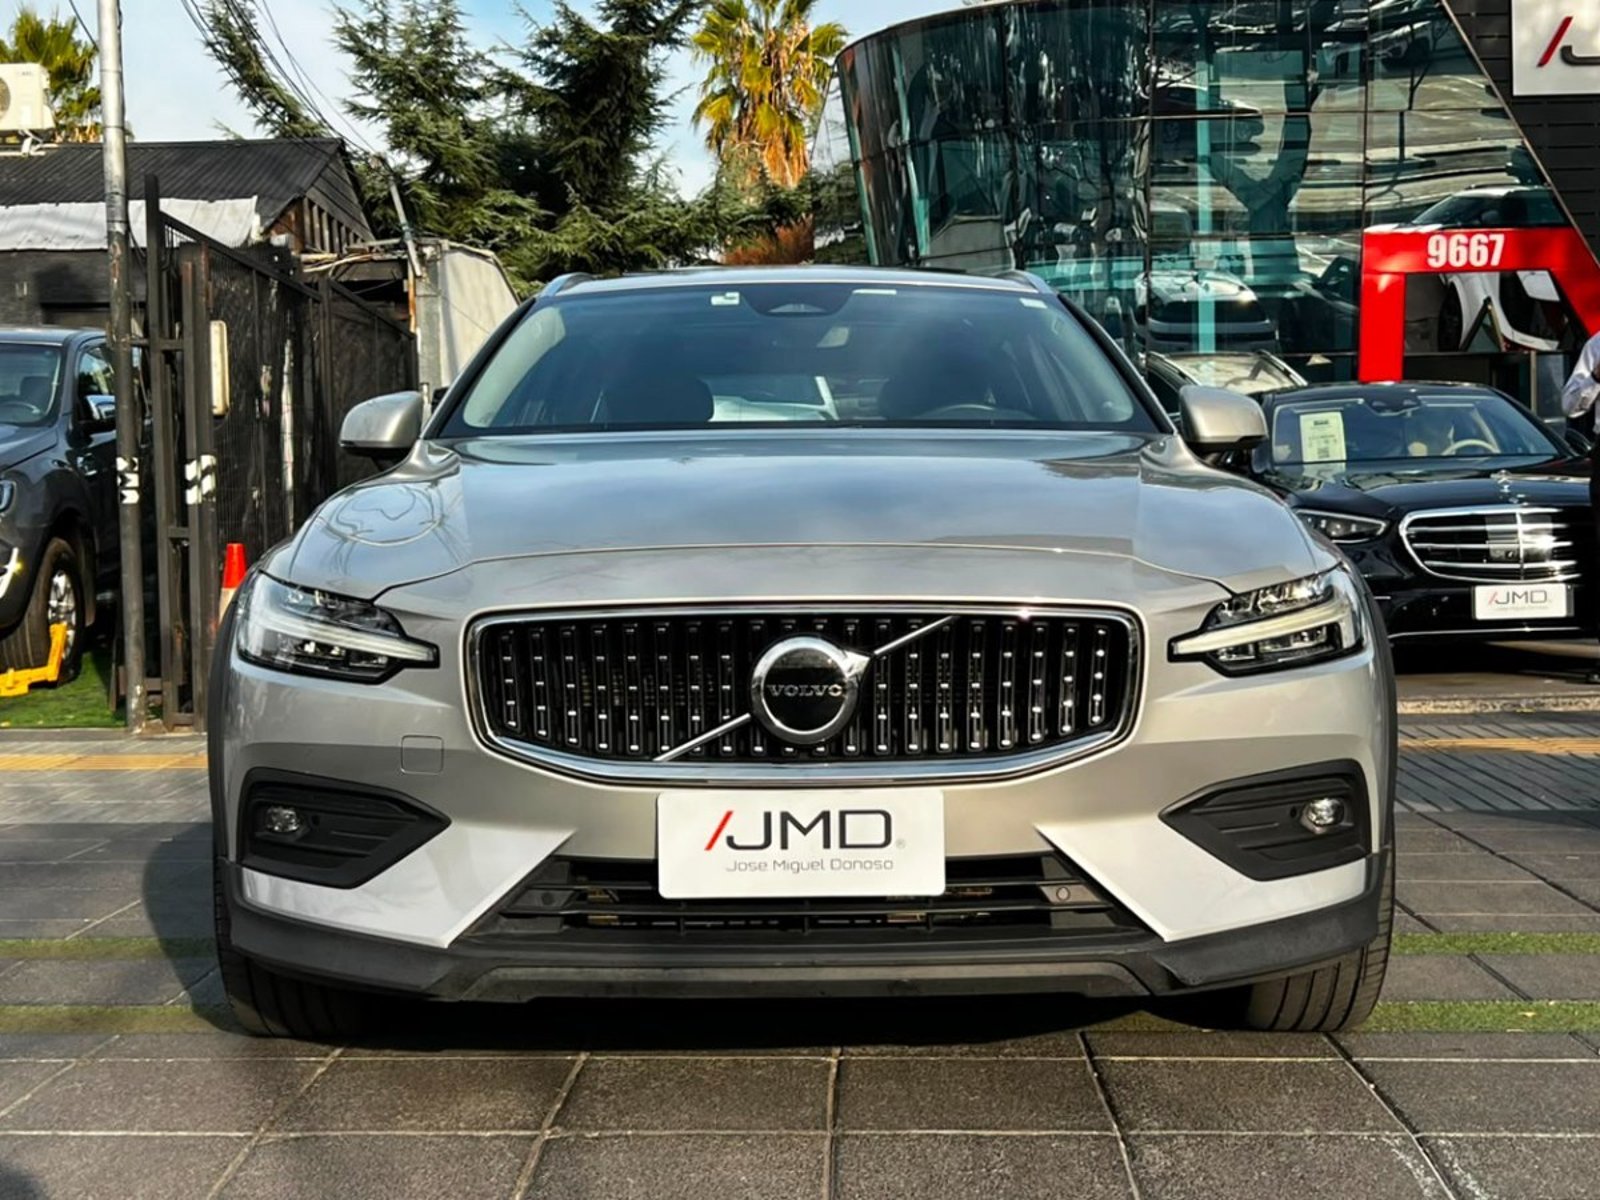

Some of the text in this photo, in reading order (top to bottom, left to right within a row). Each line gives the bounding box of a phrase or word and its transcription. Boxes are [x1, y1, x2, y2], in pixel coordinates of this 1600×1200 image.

[1427, 233, 1505, 268] 9667
[766, 683, 843, 697] VOLVO
[726, 858, 894, 874] Jose Miguel Donoso
